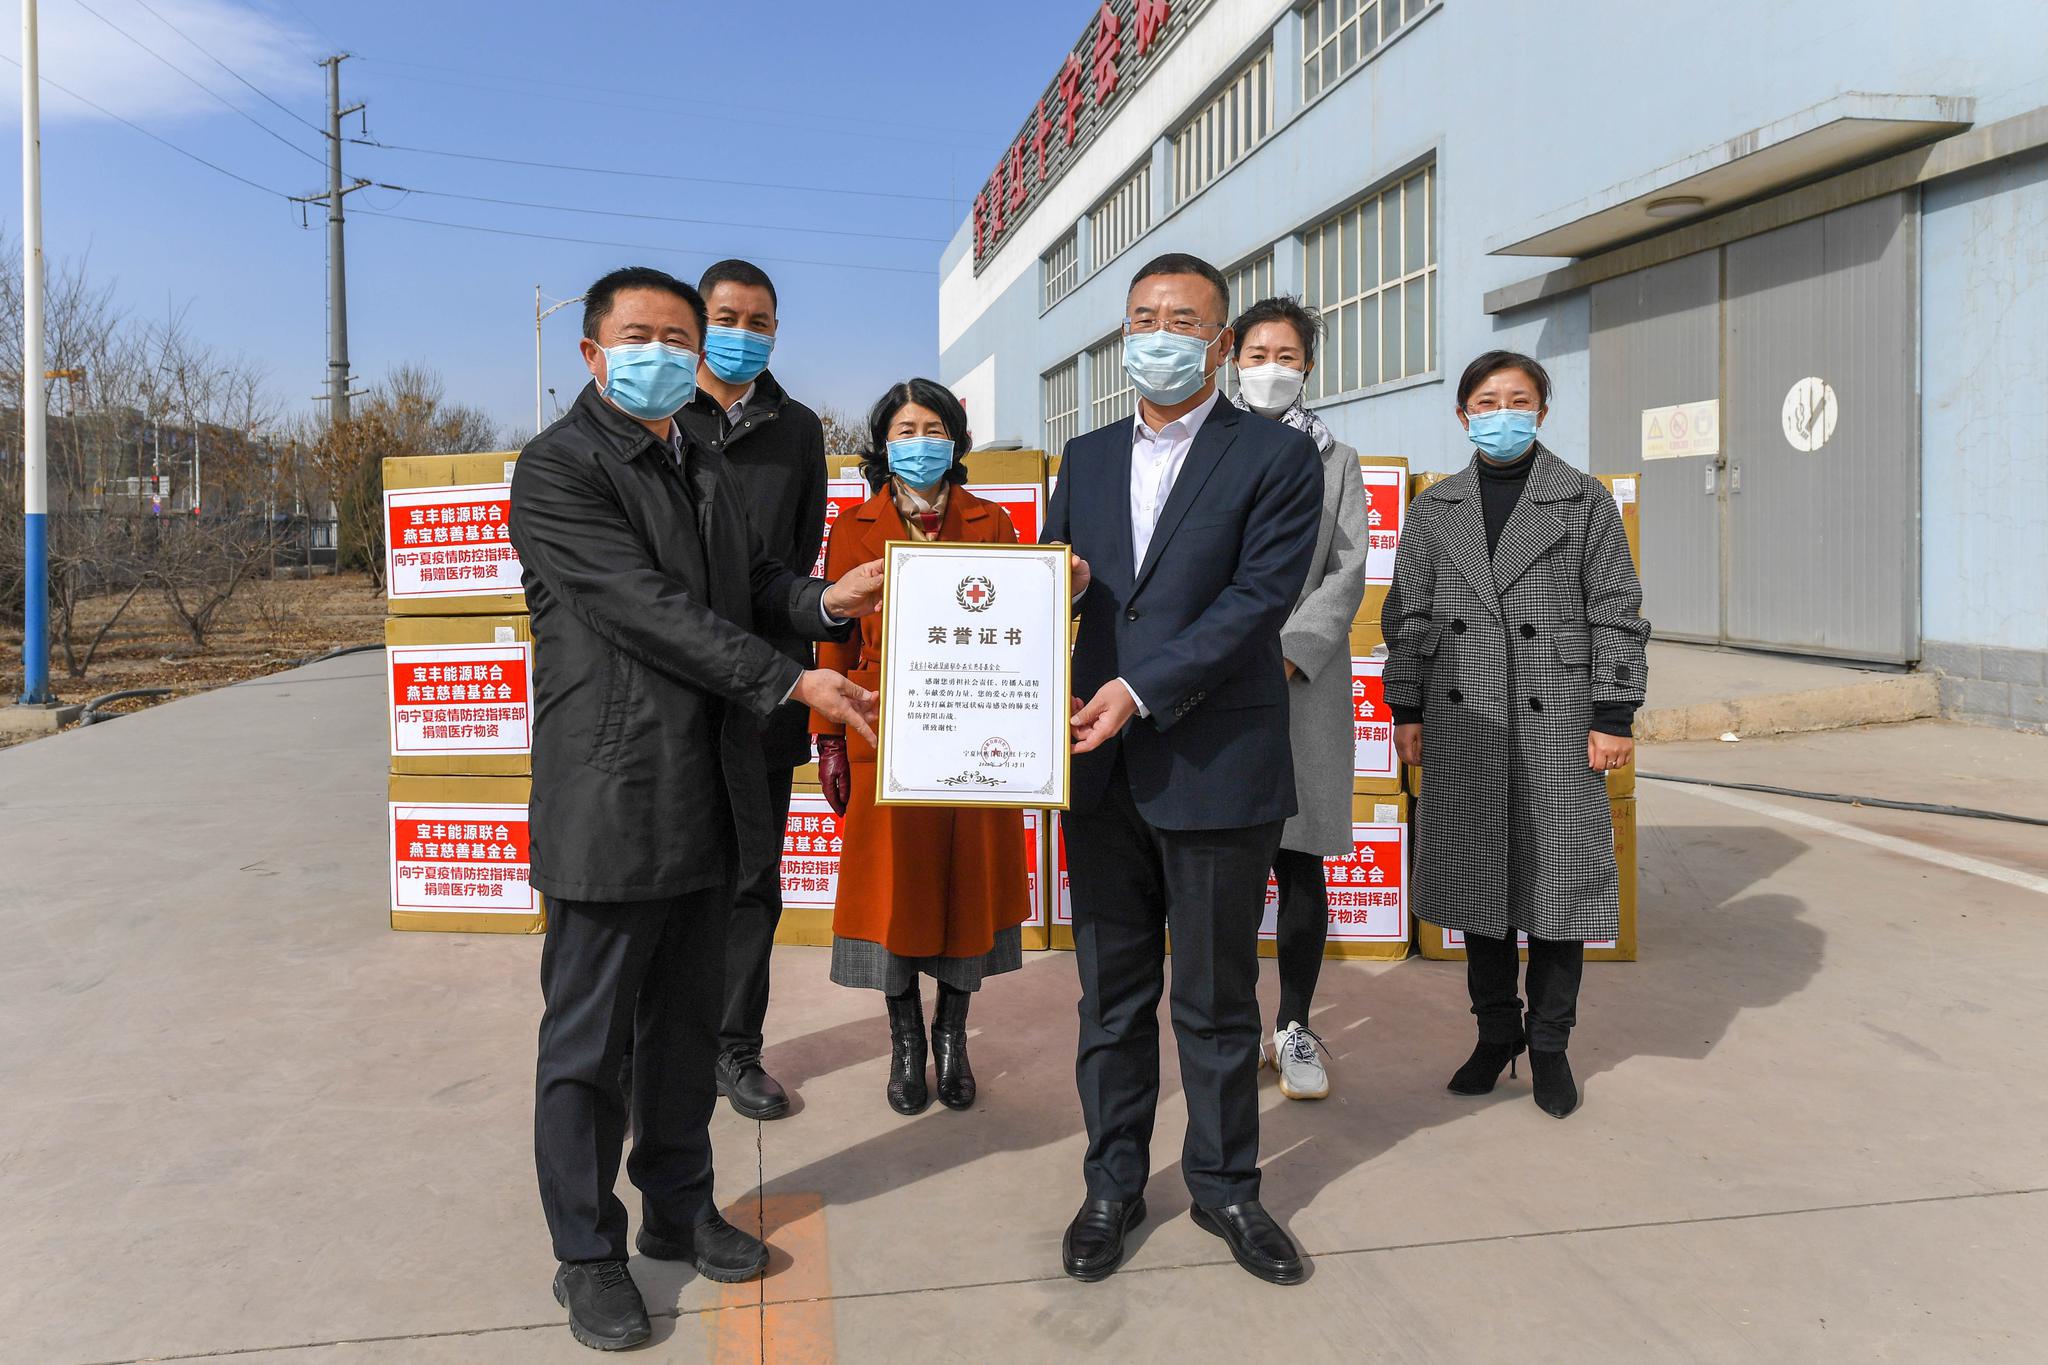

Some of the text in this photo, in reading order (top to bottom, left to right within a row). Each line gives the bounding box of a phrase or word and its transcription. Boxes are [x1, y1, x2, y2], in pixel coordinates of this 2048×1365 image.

[410, 504, 502, 526] 宝丰能源联合
[403, 522, 511, 545] 燕宝慈善基金会
[420, 565, 498, 582] 捐赠医疗物资
[928, 626, 1022, 645] 荣誉证书
[413, 664, 504, 683] 宝丰能源联合
[406, 683, 512, 702] 燕宝慈善基金会
[398, 707, 525, 723] 向宁夏疫情防控指挥部
[422, 724, 500, 739] 捐赠医疗物资
[416, 823, 509, 842] 宝丰能源联合
[409, 841, 518, 860] 燕宝慈善基金会
[399, 865, 529, 882] 向宁夏疫情防控指挥部
[424, 882, 504, 897] 捐赠医疗物资
